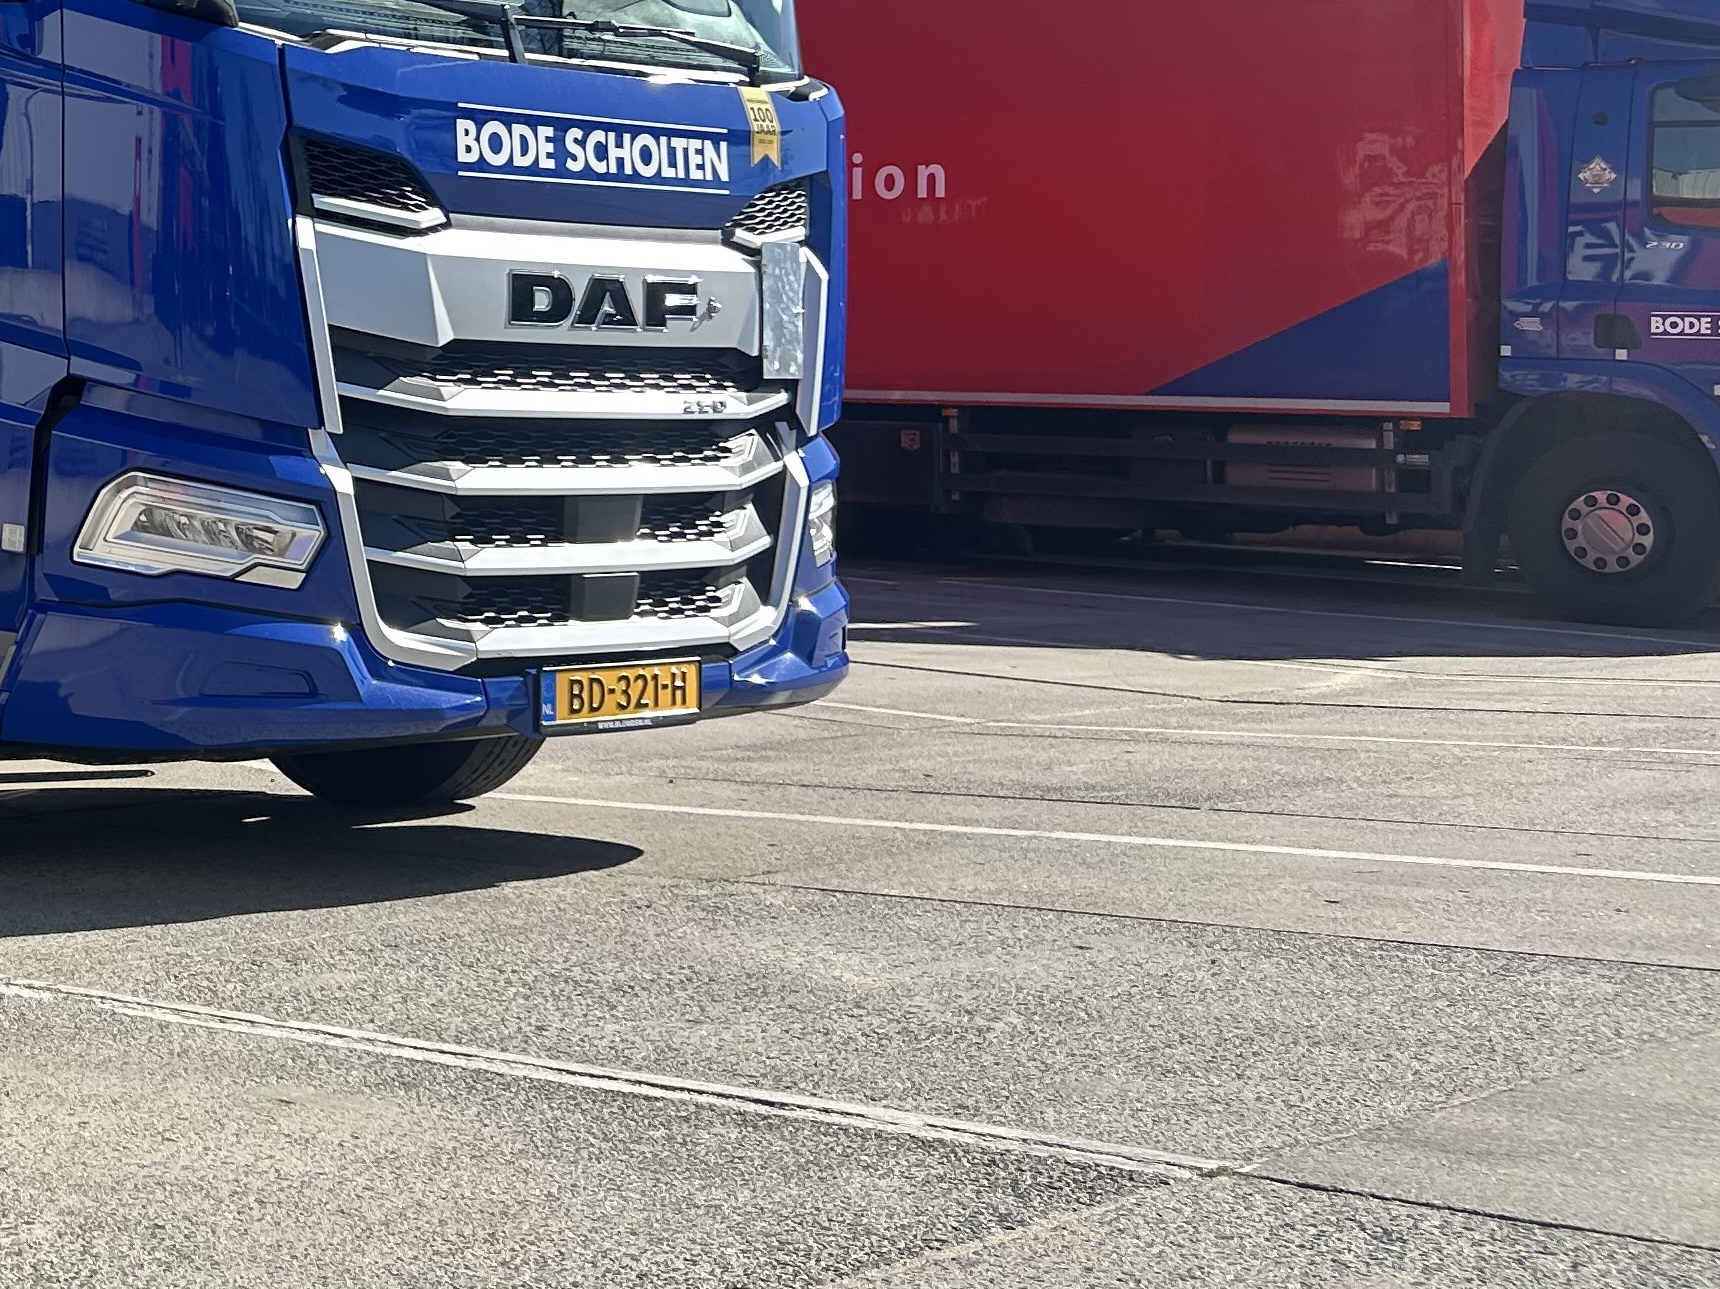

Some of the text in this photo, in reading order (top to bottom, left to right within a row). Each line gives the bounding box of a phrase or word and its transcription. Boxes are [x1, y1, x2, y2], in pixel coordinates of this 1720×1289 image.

[750, 107, 773, 123] 100
[456, 119, 729, 182] BODE SCHOLTEN
[852, 153, 946, 200] ion
[505, 269, 700, 332] DAF
[1651, 316, 1711, 334] BODE
[542, 703, 555, 715] NL
[568, 666, 688, 715] BD-321-H
